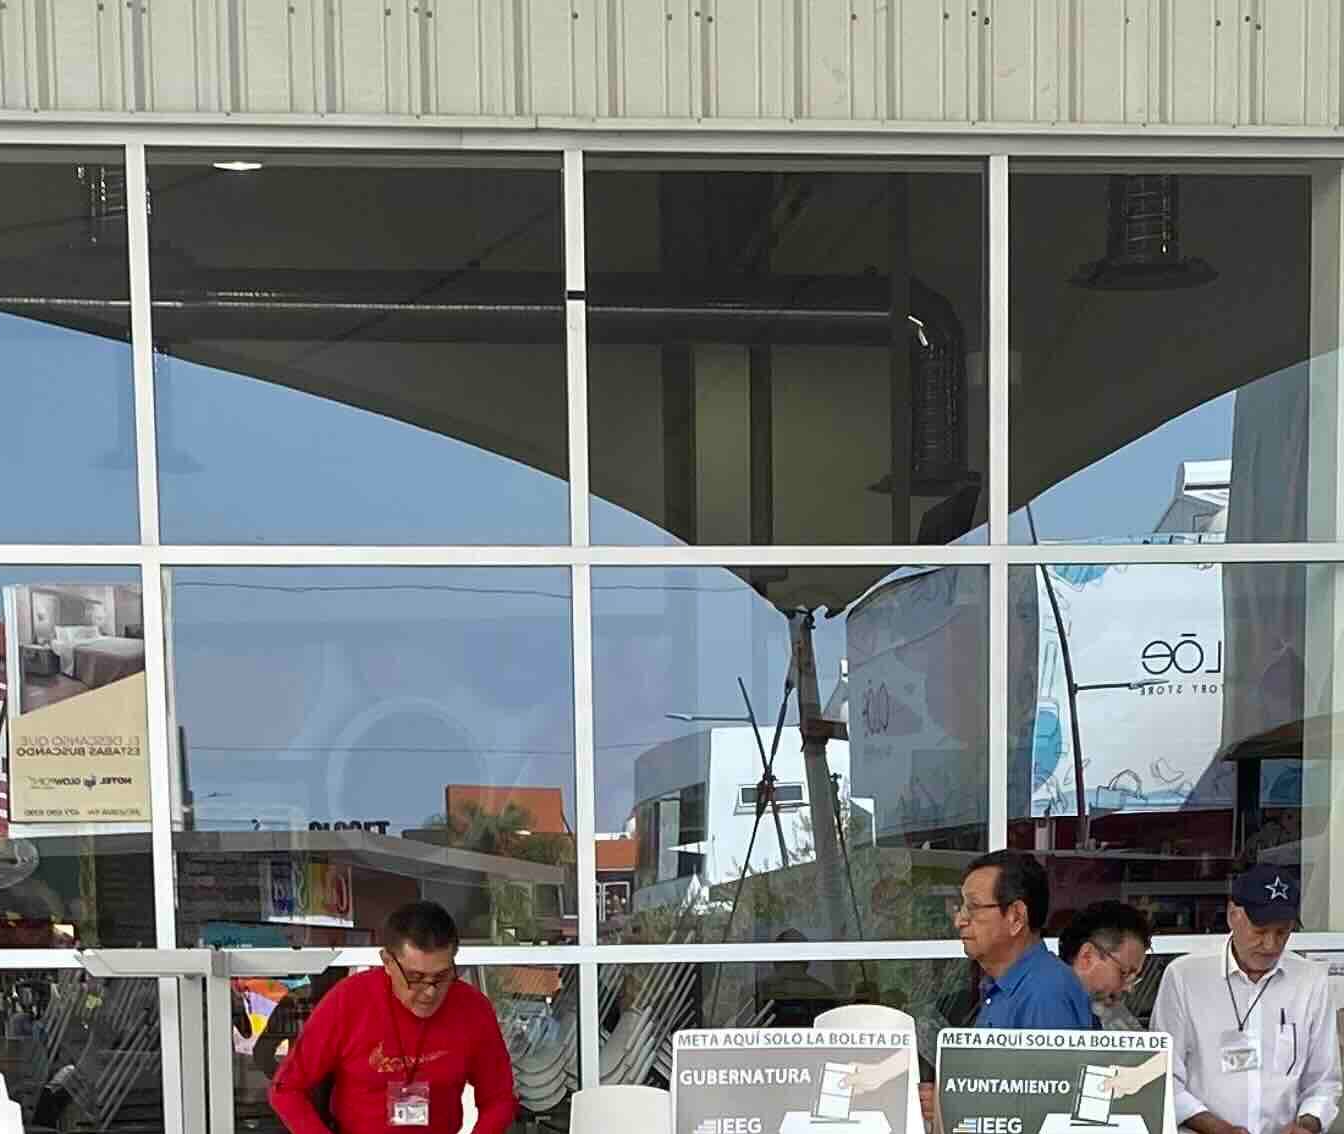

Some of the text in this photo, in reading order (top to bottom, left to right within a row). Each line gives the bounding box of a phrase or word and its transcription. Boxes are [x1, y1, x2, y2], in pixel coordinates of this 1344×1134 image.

[678, 1031, 911, 1048] META AQUÍ SOLO LA BOLETA DE
[942, 1031, 1168, 1049] META AQUÍ SOLO LA BOLETA DE
[680, 1067, 812, 1086] GUBERNATURA
[945, 1078, 1070, 1094] AYUNTAMIENTO
[718, 1118, 762, 1134] IEEG
[977, 1117, 1022, 1134] IEEG
